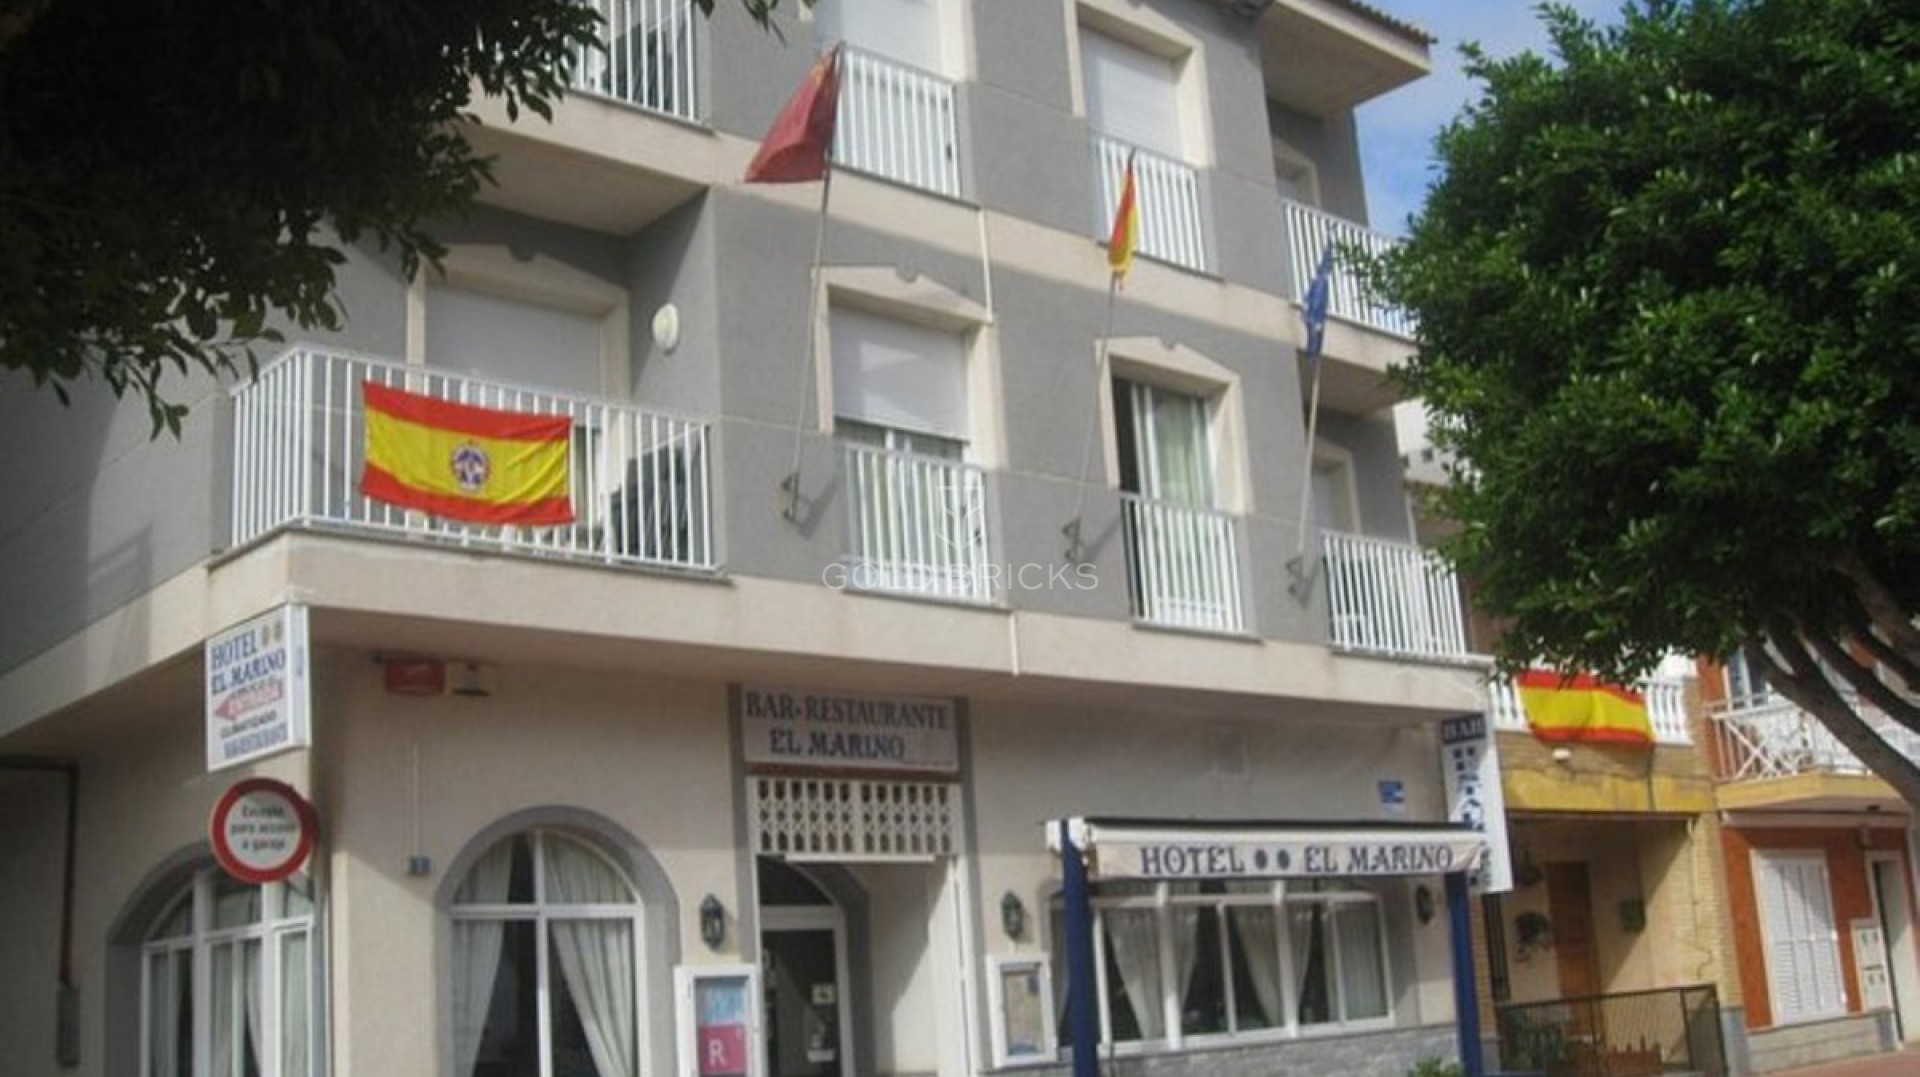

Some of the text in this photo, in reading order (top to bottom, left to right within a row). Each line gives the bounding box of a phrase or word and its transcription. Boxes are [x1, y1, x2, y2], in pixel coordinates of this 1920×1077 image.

[211, 629, 258, 671] HOTEL
[211, 671, 227, 696] EL
[232, 647, 287, 687] MARINO
[769, 726, 906, 760] EL MARINO
[1140, 844, 1454, 875] HOTEL EL MARINO
[708, 1038, 729, 1068] R
